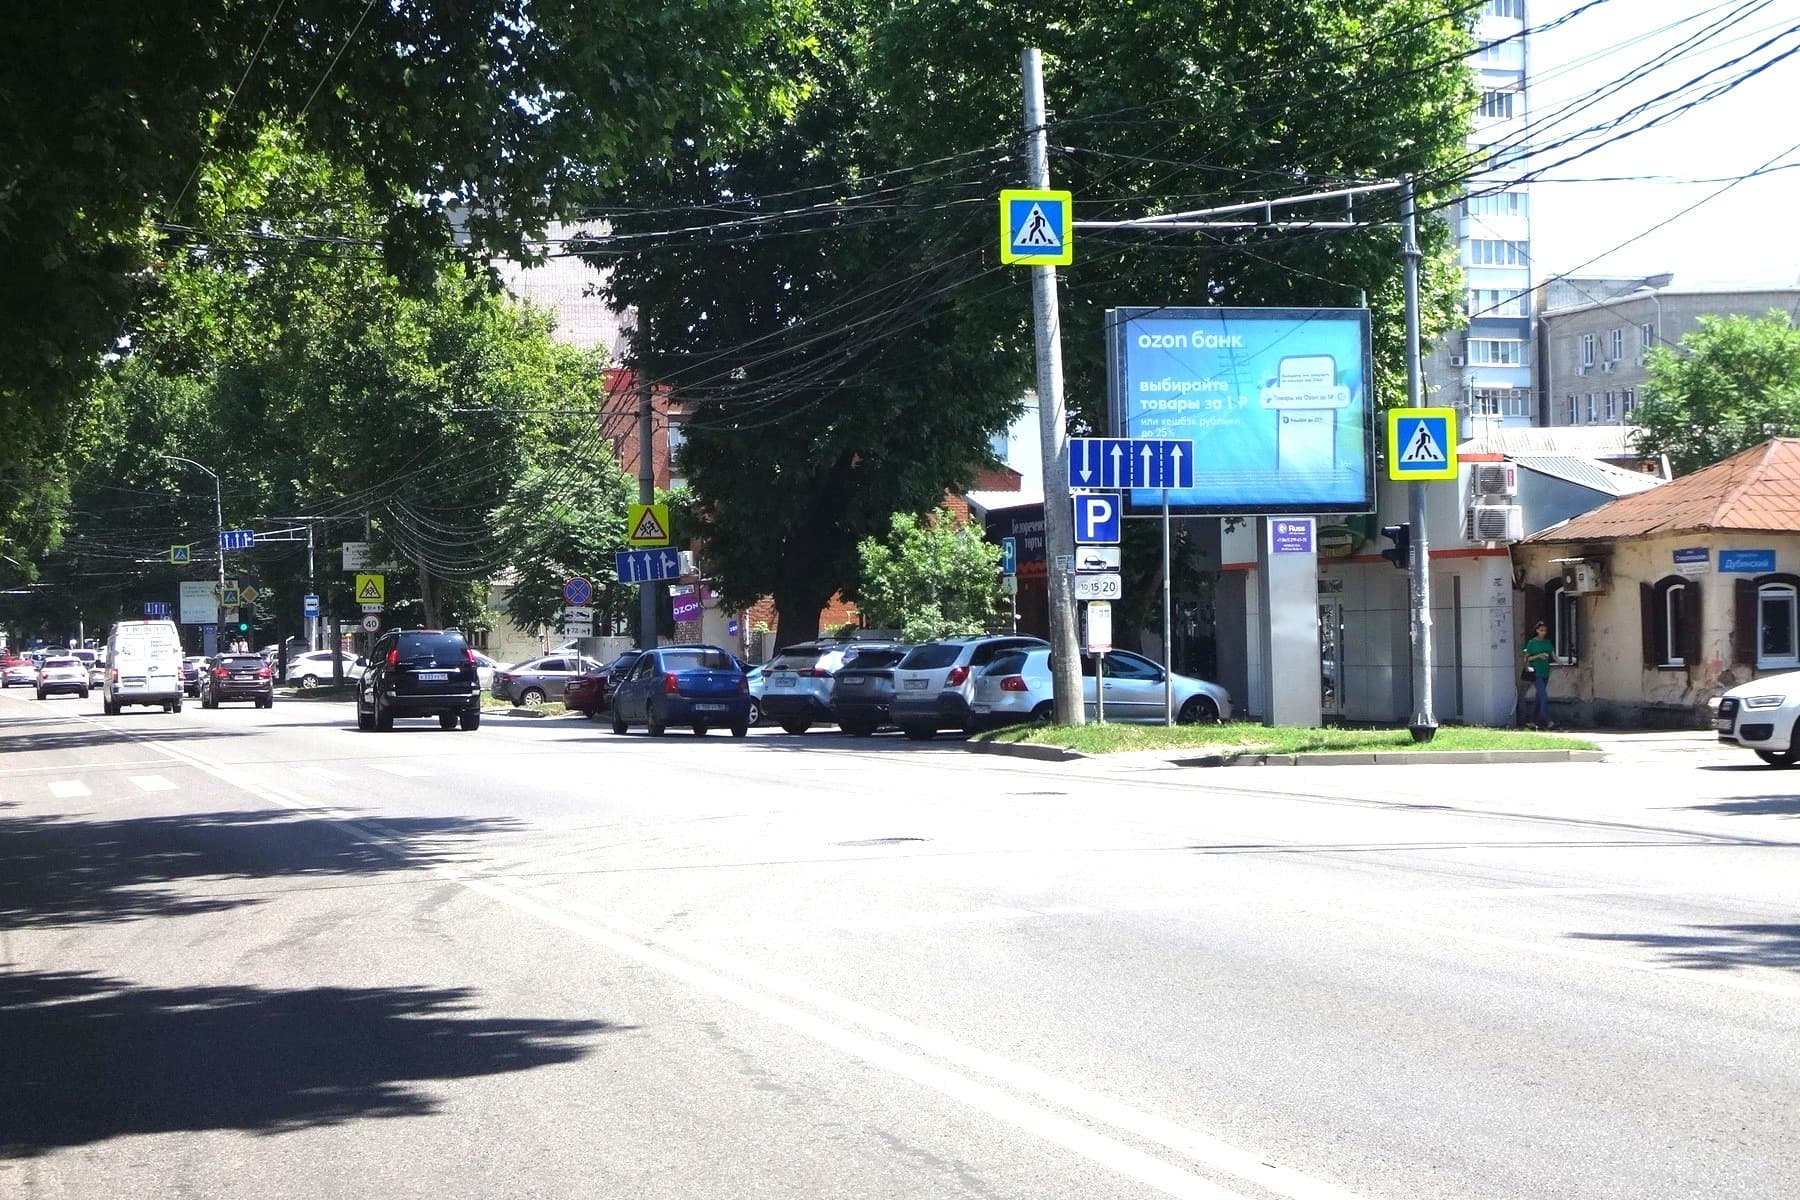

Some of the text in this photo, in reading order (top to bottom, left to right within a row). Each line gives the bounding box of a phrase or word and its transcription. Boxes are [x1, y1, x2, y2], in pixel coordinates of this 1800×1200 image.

[1138, 330, 1243, 348] ozon банк
[1140, 377, 1229, 394] выбирайте
[1141, 399, 1200, 413] товары
[1205, 400, 1222, 409] за
[1141, 430, 1153, 438] до
[1087, 499, 1112, 538] P
[1081, 581, 1116, 592] 10 15 20
[673, 602, 699, 615] OZON
[366, 620, 377, 628] 40
